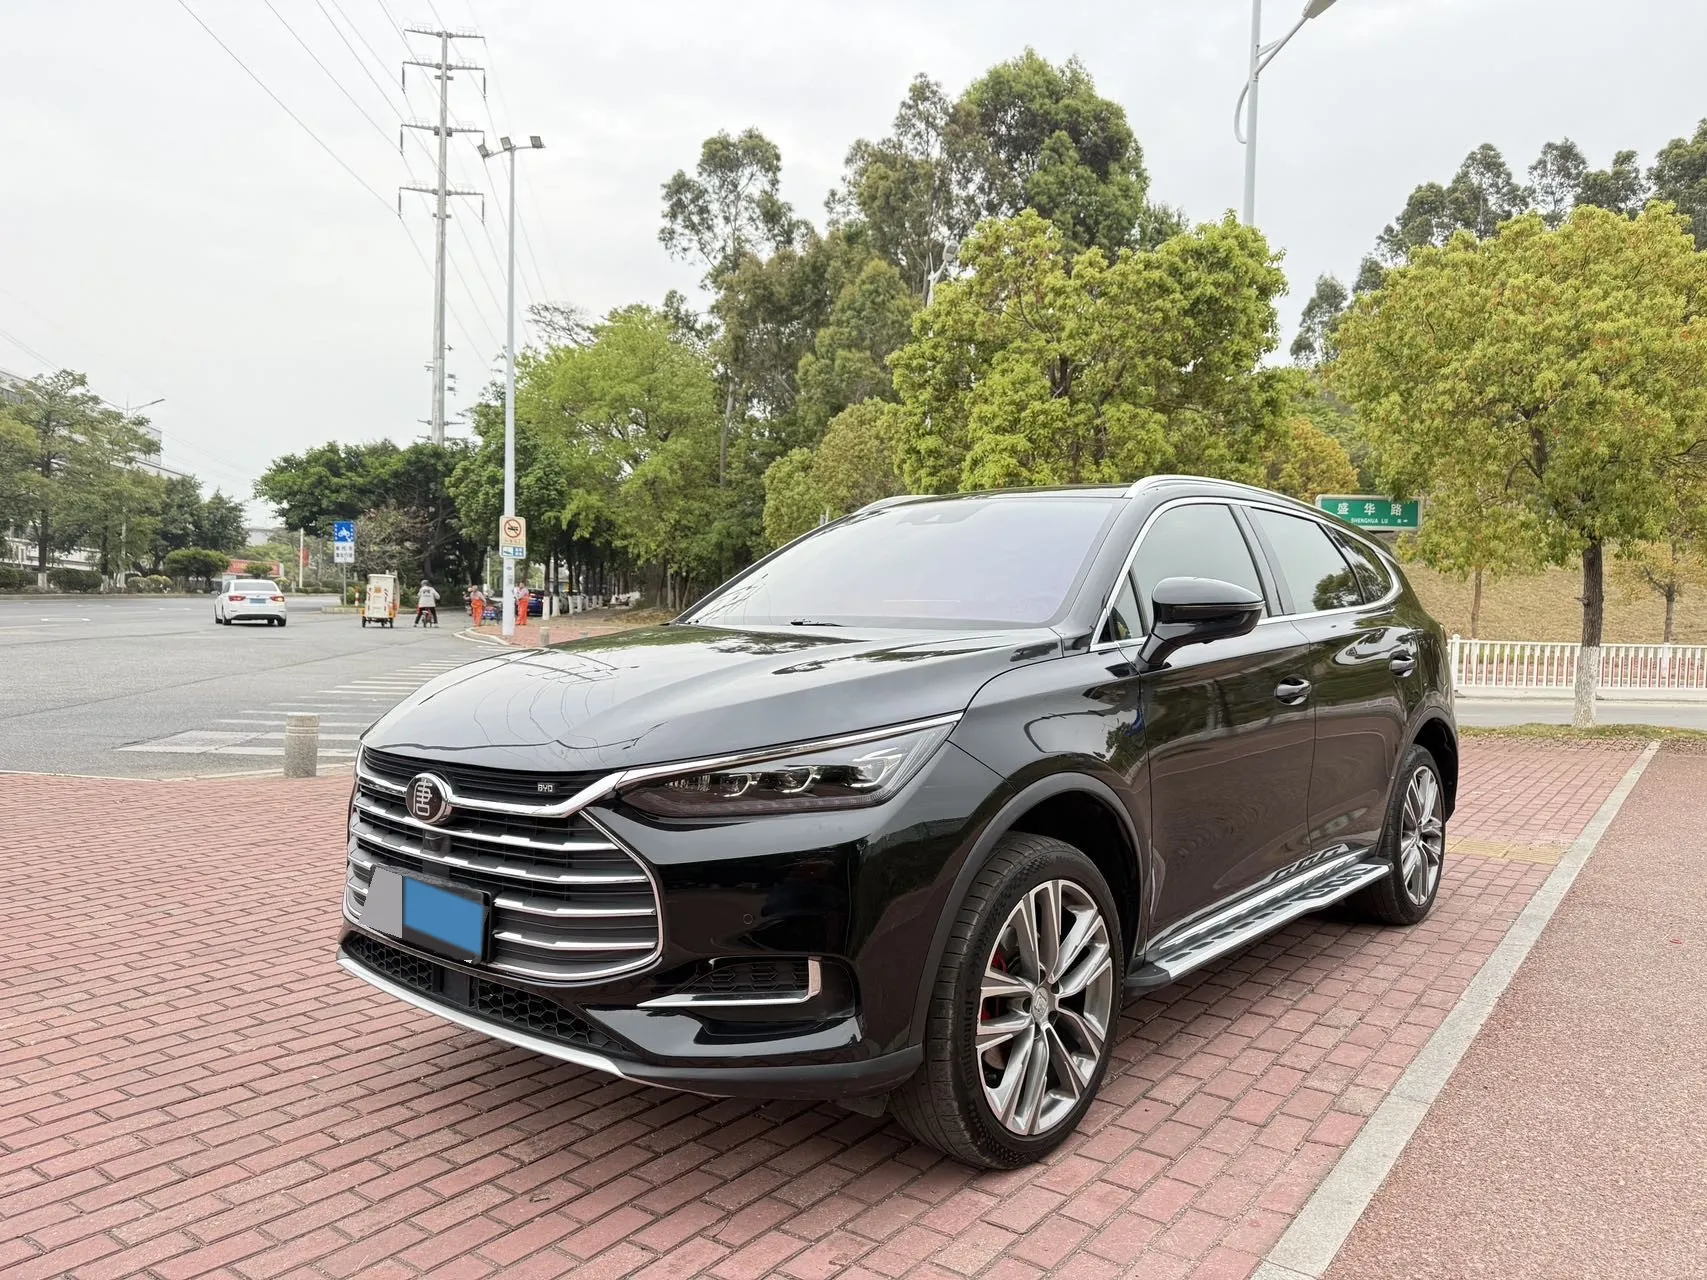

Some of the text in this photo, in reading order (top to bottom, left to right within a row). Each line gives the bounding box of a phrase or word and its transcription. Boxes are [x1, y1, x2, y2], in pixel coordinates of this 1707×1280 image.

[1337, 502, 1403, 516] 盛华路
[537, 783, 553, 792] BYD
